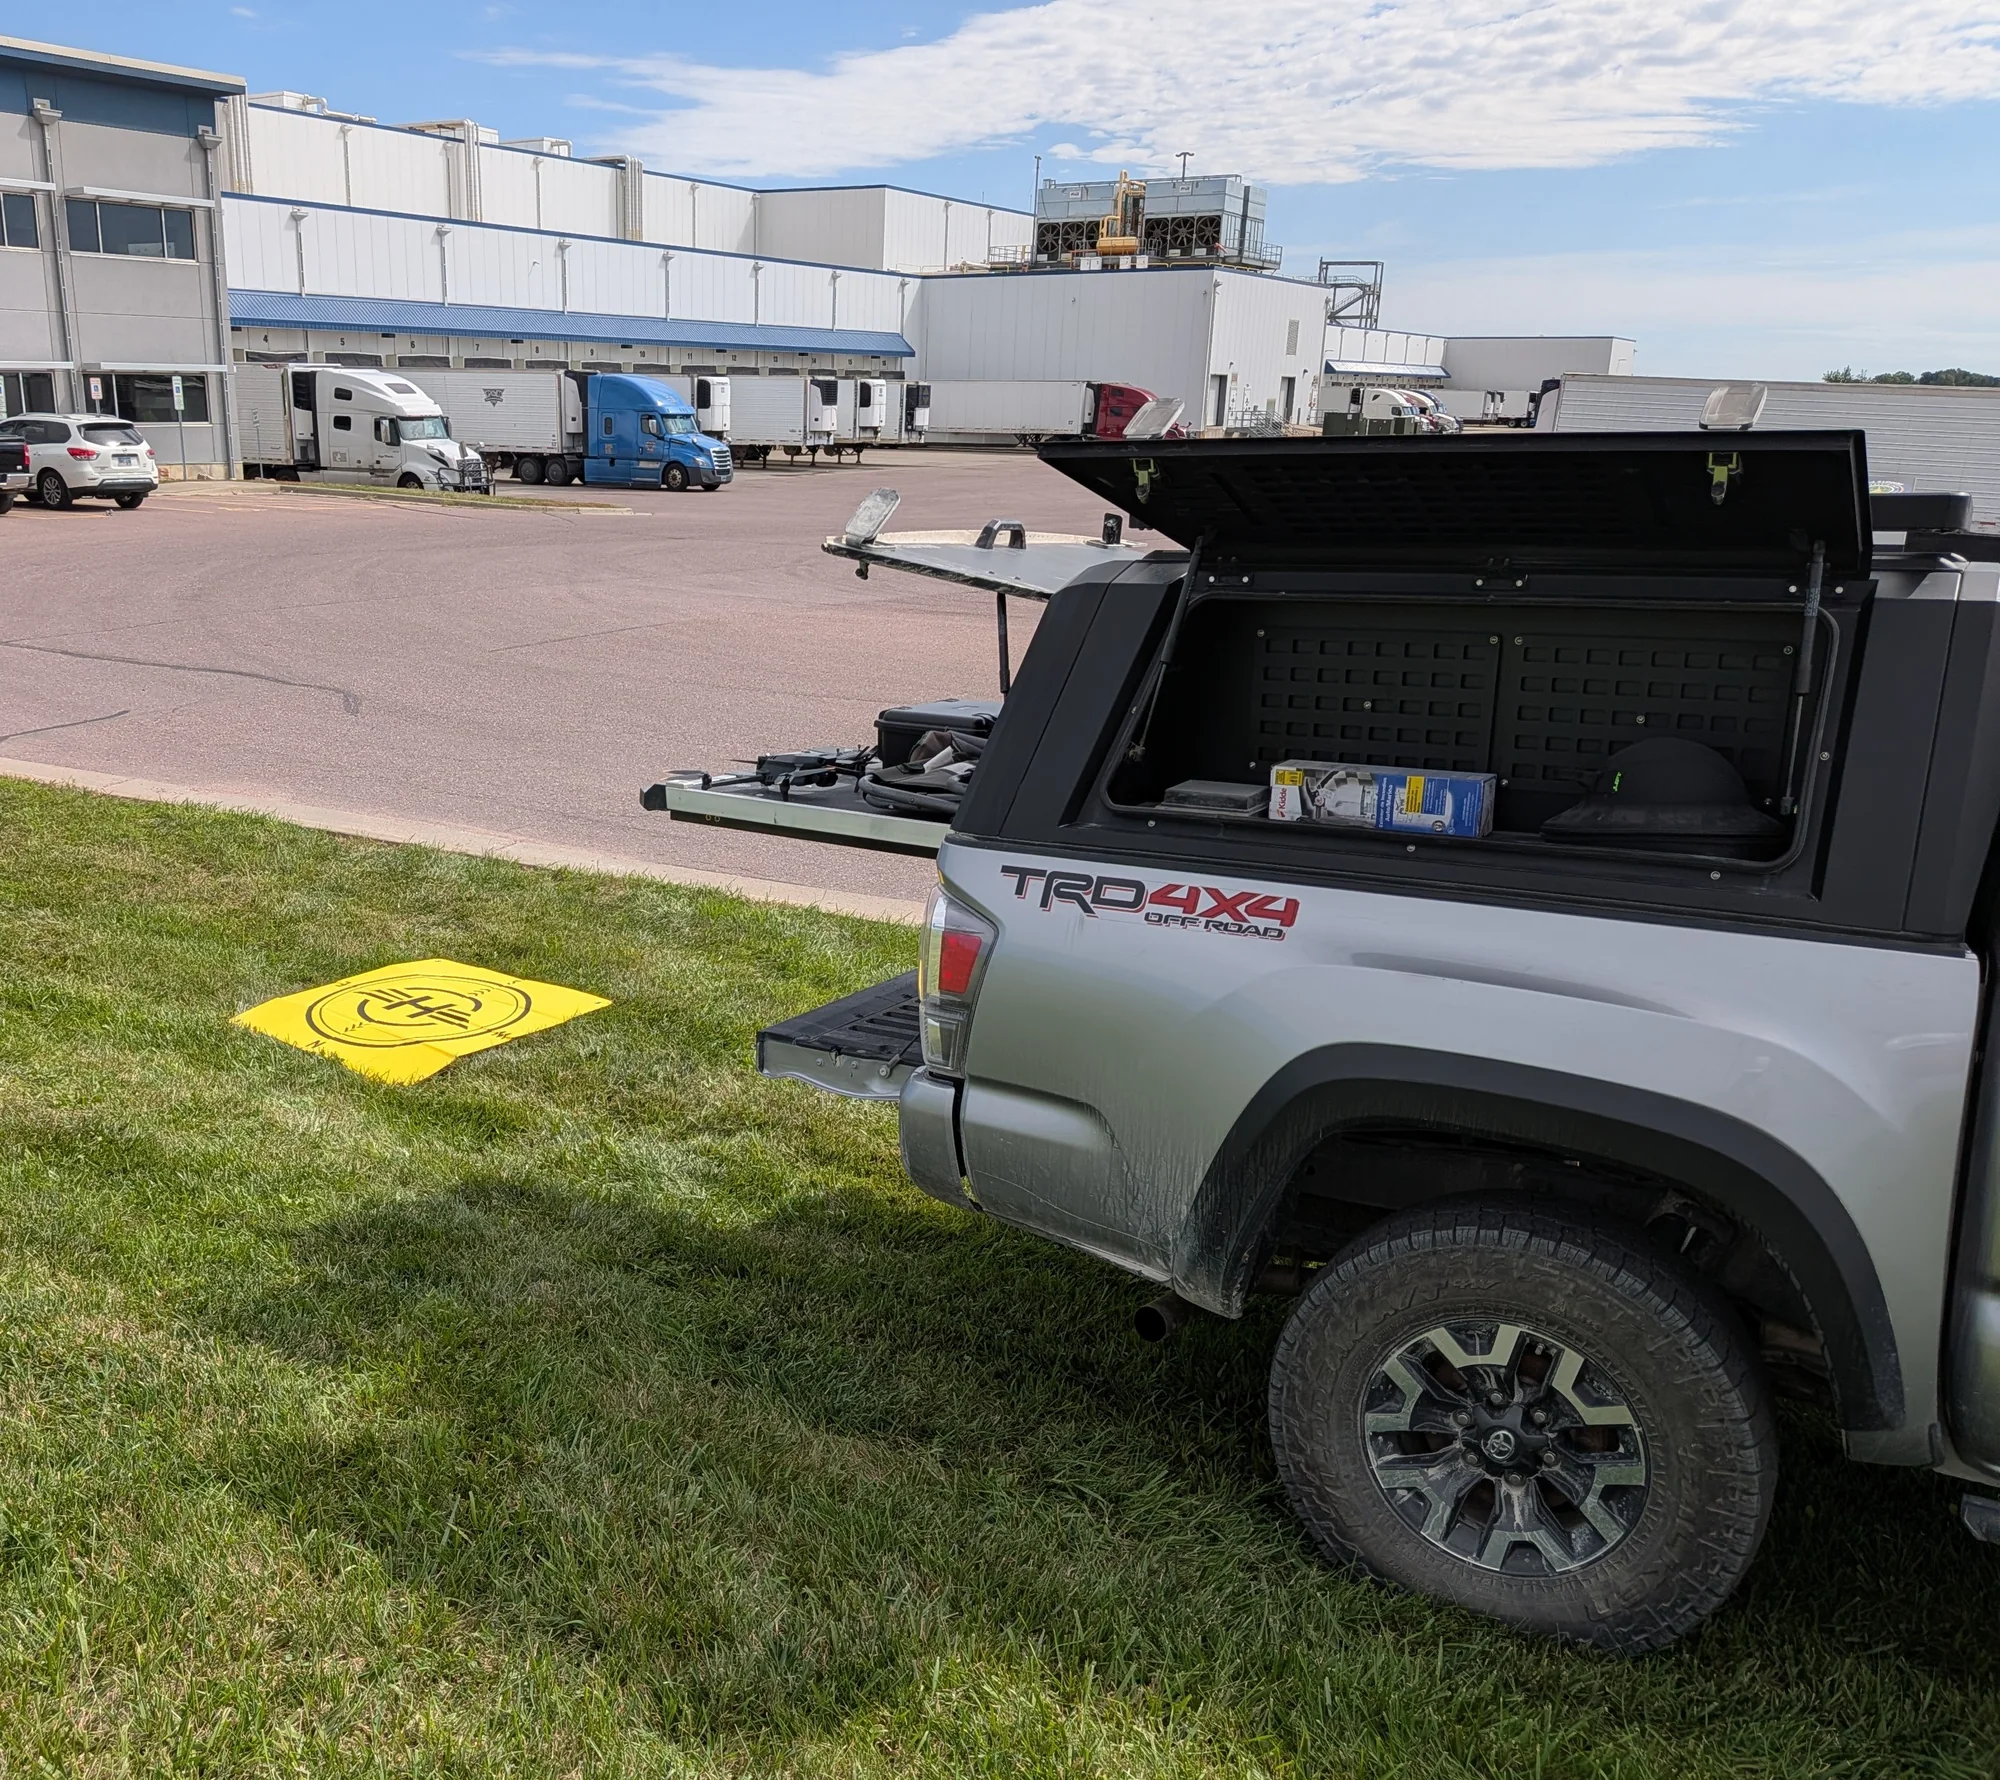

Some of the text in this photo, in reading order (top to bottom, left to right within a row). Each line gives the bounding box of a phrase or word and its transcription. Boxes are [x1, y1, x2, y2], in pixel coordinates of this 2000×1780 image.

[1278, 787, 1287, 810] Kidde
[1000, 864, 1301, 928] TRD 4X4
[1143, 912, 1286, 941] OFF ROAD
[382, 995, 457, 1019] H
[305, 1039, 326, 1049] N
